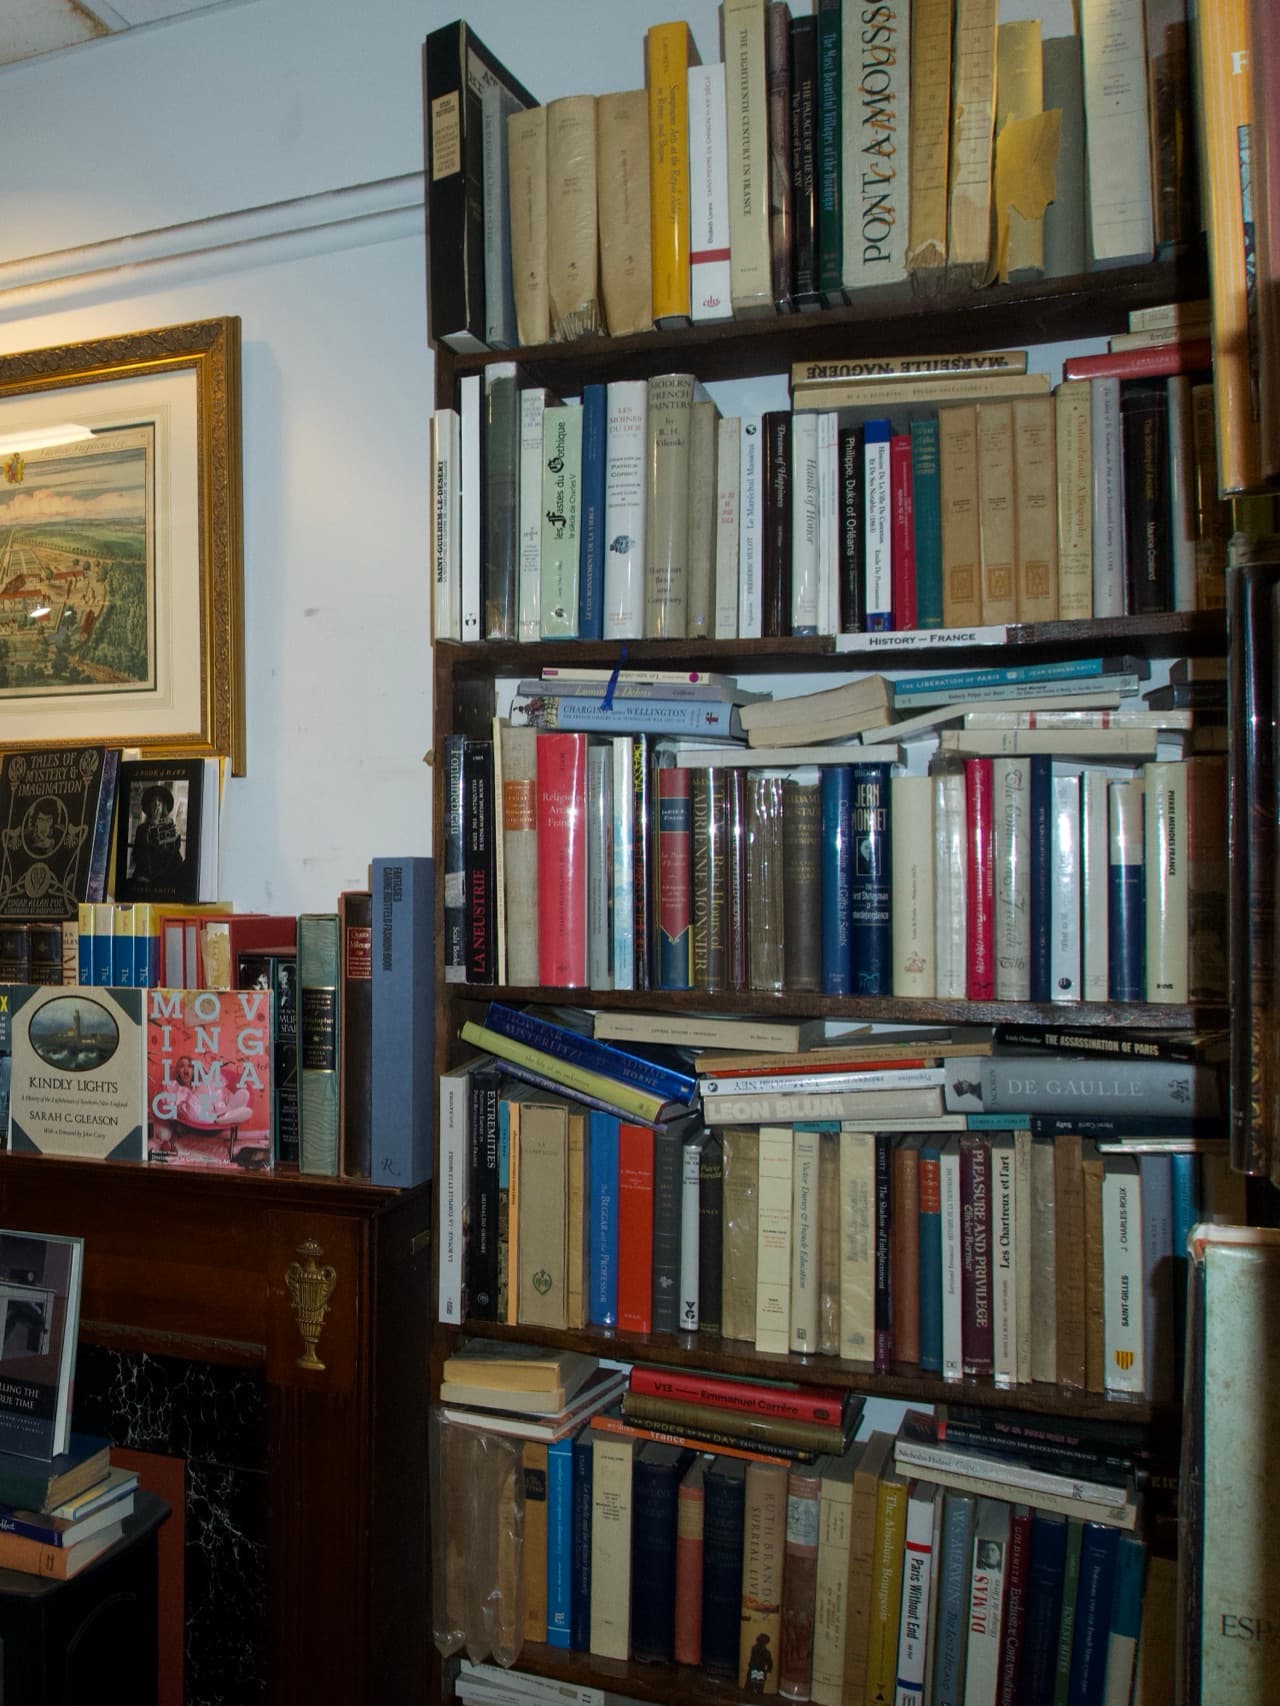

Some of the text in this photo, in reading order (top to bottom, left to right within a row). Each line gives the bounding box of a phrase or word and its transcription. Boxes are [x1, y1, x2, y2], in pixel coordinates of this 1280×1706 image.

[739, 29, 752, 216] THE EIGHTEENTH CENTURY IN FRANCE
[900, 356, 1008, 373] MARSEILLE
[777, 424, 786, 455] Dreams
[547, 422, 567, 540] les Fastes du Gothique
[774, 467, 787, 508] Happiness
[806, 459, 817, 544] Hands of Honor
[845, 437, 857, 555] Philippe, Duke of Orléans
[870, 633, 976, 645] HISTORY FRANCE
[917, 678, 963, 688] LIBERATION
[627, 708, 686, 717] WELLINGTON
[63, 751, 77, 762] OF
[18, 780, 82, 797] IMAGINATION
[856, 784, 880, 807] JEAN
[852, 808, 886, 831] MONNET
[1168, 847, 1176, 876] FRANCE
[383, 867, 392, 891] CARINE
[393, 867, 402, 902] FANTASIES
[694, 792, 708, 969] ADRIENNE MONNIER
[840, 873, 848, 887] and
[471, 869, 486, 972] LA NEUSTRIE
[383, 924, 392, 952] FASHION
[711, 940, 724, 951] of
[383, 953, 392, 971] BOOK
[1044, 1034, 1160, 1057] THE ASSASSINATION OF PARIS
[29, 1077, 118, 1094] KINDLY LIGHTS
[734, 1080, 757, 1091] NEY
[1008, 1078, 1144, 1097] DE GAULLE
[29, 1110, 58, 1122] SARAH
[75, 1112, 118, 1126] GLEASON
[776, 1099, 844, 1116] BLUM
[487, 1090, 496, 1168] EXTREMITIES
[1000, 1180, 1010, 1189] et
[999, 1193, 1010, 1247] Chartreux
[599, 1196, 609, 1302] BEGGAR PROFESSOR
[800, 1223, 808, 1248] French
[878, 1186, 888, 1289] The Shadow of Enlightenment
[972, 1150, 988, 1328] PLEASURE AND PRIVILEGE
[965, 1236, 973, 1272] Bernier
[1000, 1250, 1010, 1269] Les
[1119, 1187, 1129, 1327] SAINT-GILLES CHARLES-ROUX
[799, 1250, 808, 1288] Education
[17, 1397, 34, 1409] TIME
[24, 1386, 39, 1399] THE
[653, 1382, 799, 1415] V13 Emmanuel Carrère
[645, 1418, 684, 1433] ORDER
[714, 1433, 738, 1448] DAY
[765, 1493, 775, 1535] RUTH
[885, 1494, 897, 1515] The
[750, 1507, 761, 1564] SURREAL
[880, 1568, 894, 1620] Bourgeois
[907, 1559, 924, 1639] Paris Without End
[970, 1575, 989, 1635] DUMAS
[1008, 1587, 1025, 1636] Exclusive
